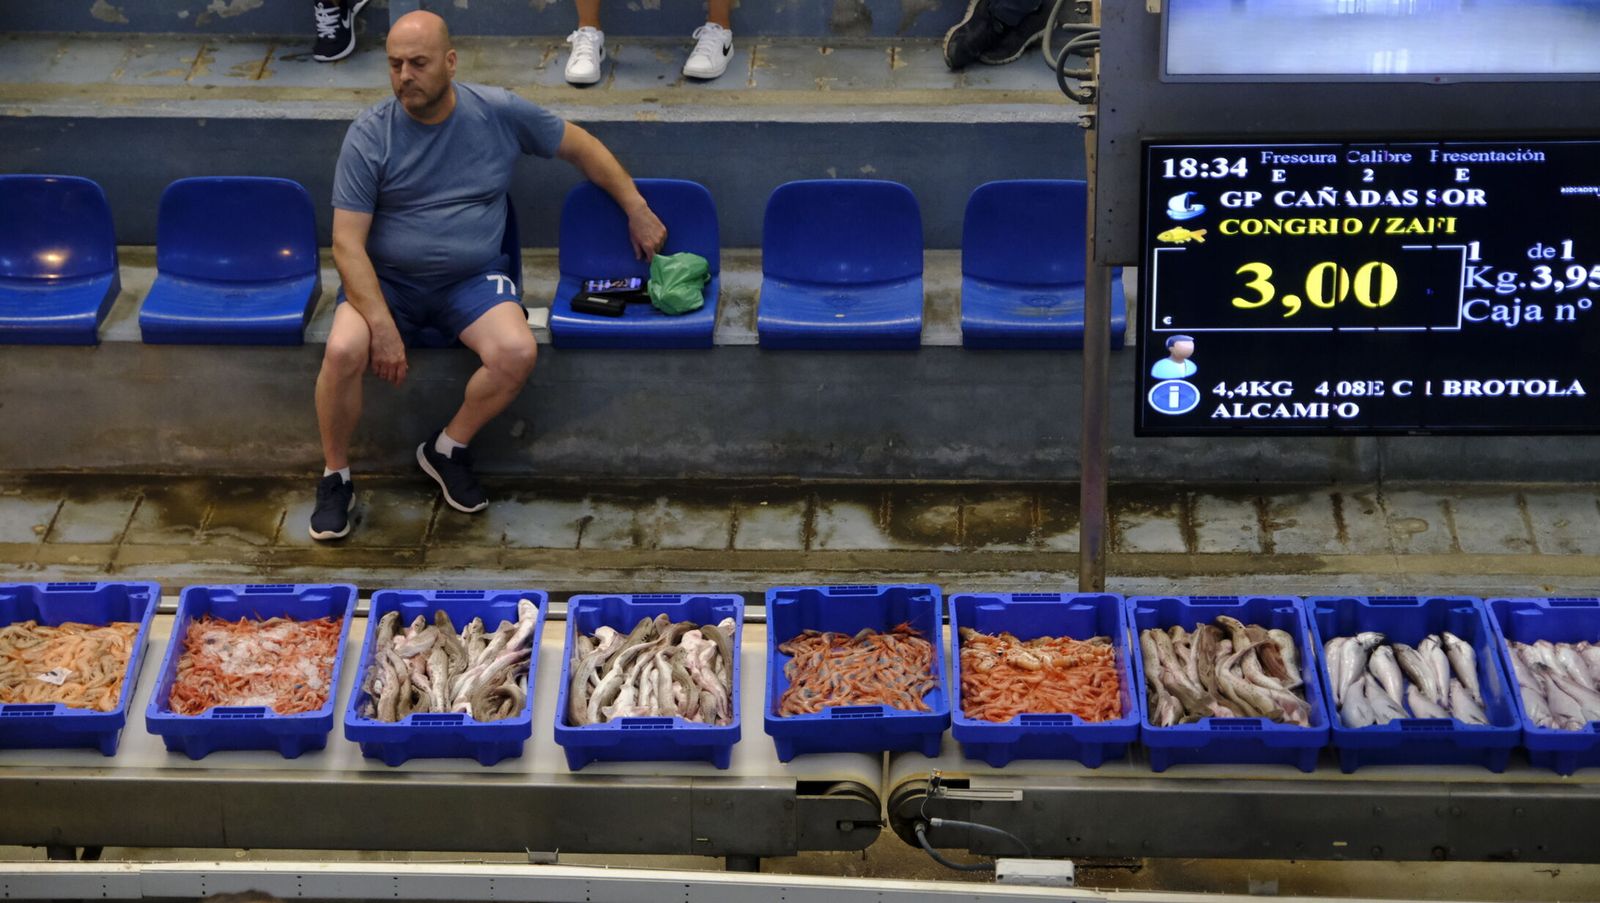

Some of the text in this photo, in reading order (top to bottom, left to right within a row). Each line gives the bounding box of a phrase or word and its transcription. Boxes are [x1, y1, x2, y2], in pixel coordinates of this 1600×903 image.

[1260, 147, 1546, 164] Frescura Calibre Presentación
[1162, 157, 1249, 179] 18:34
[1270, 168, 1470, 183] E 2 E
[1219, 190, 1263, 208] GP
[1218, 217, 1363, 235] CONGRIO
[1466, 239, 1575, 262] 1 de 1
[1231, 261, 1399, 318] 3,00
[1462, 297, 1544, 327] Caja
[1212, 380, 1294, 399] 4,4KG
[1392, 380, 1413, 396] C
[1442, 379, 1587, 397] BROTOLA
